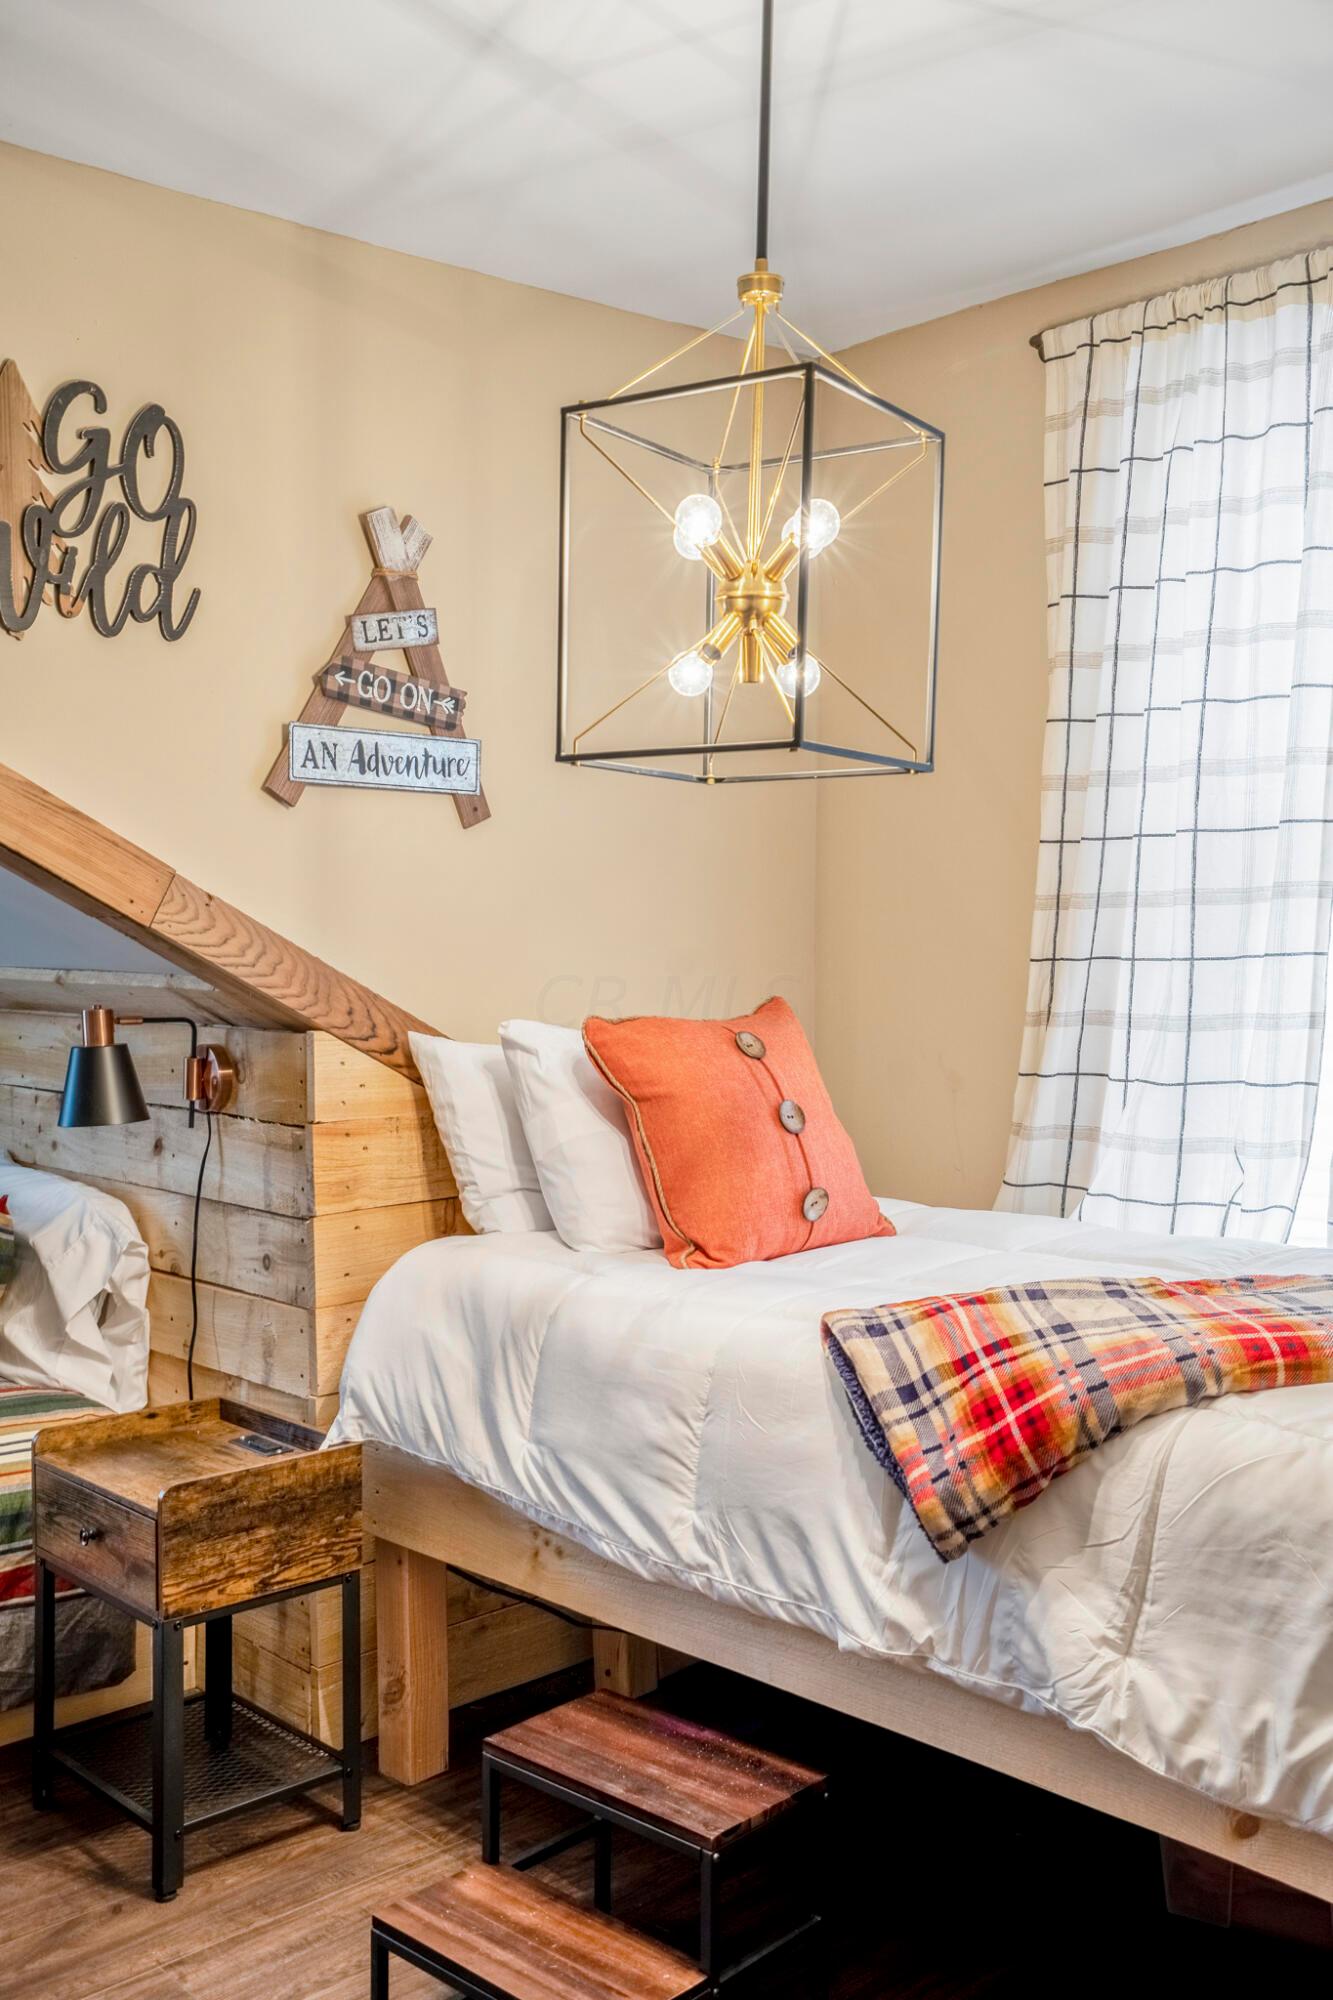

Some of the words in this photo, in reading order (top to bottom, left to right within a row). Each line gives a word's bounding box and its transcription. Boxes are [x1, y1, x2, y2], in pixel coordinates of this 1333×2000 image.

[359, 614, 430, 644] LET'S
[357, 670, 392, 703] GO
[400, 682, 434, 714] ON
[300, 738, 339, 771] AN
[348, 738, 471, 780] Adventure
